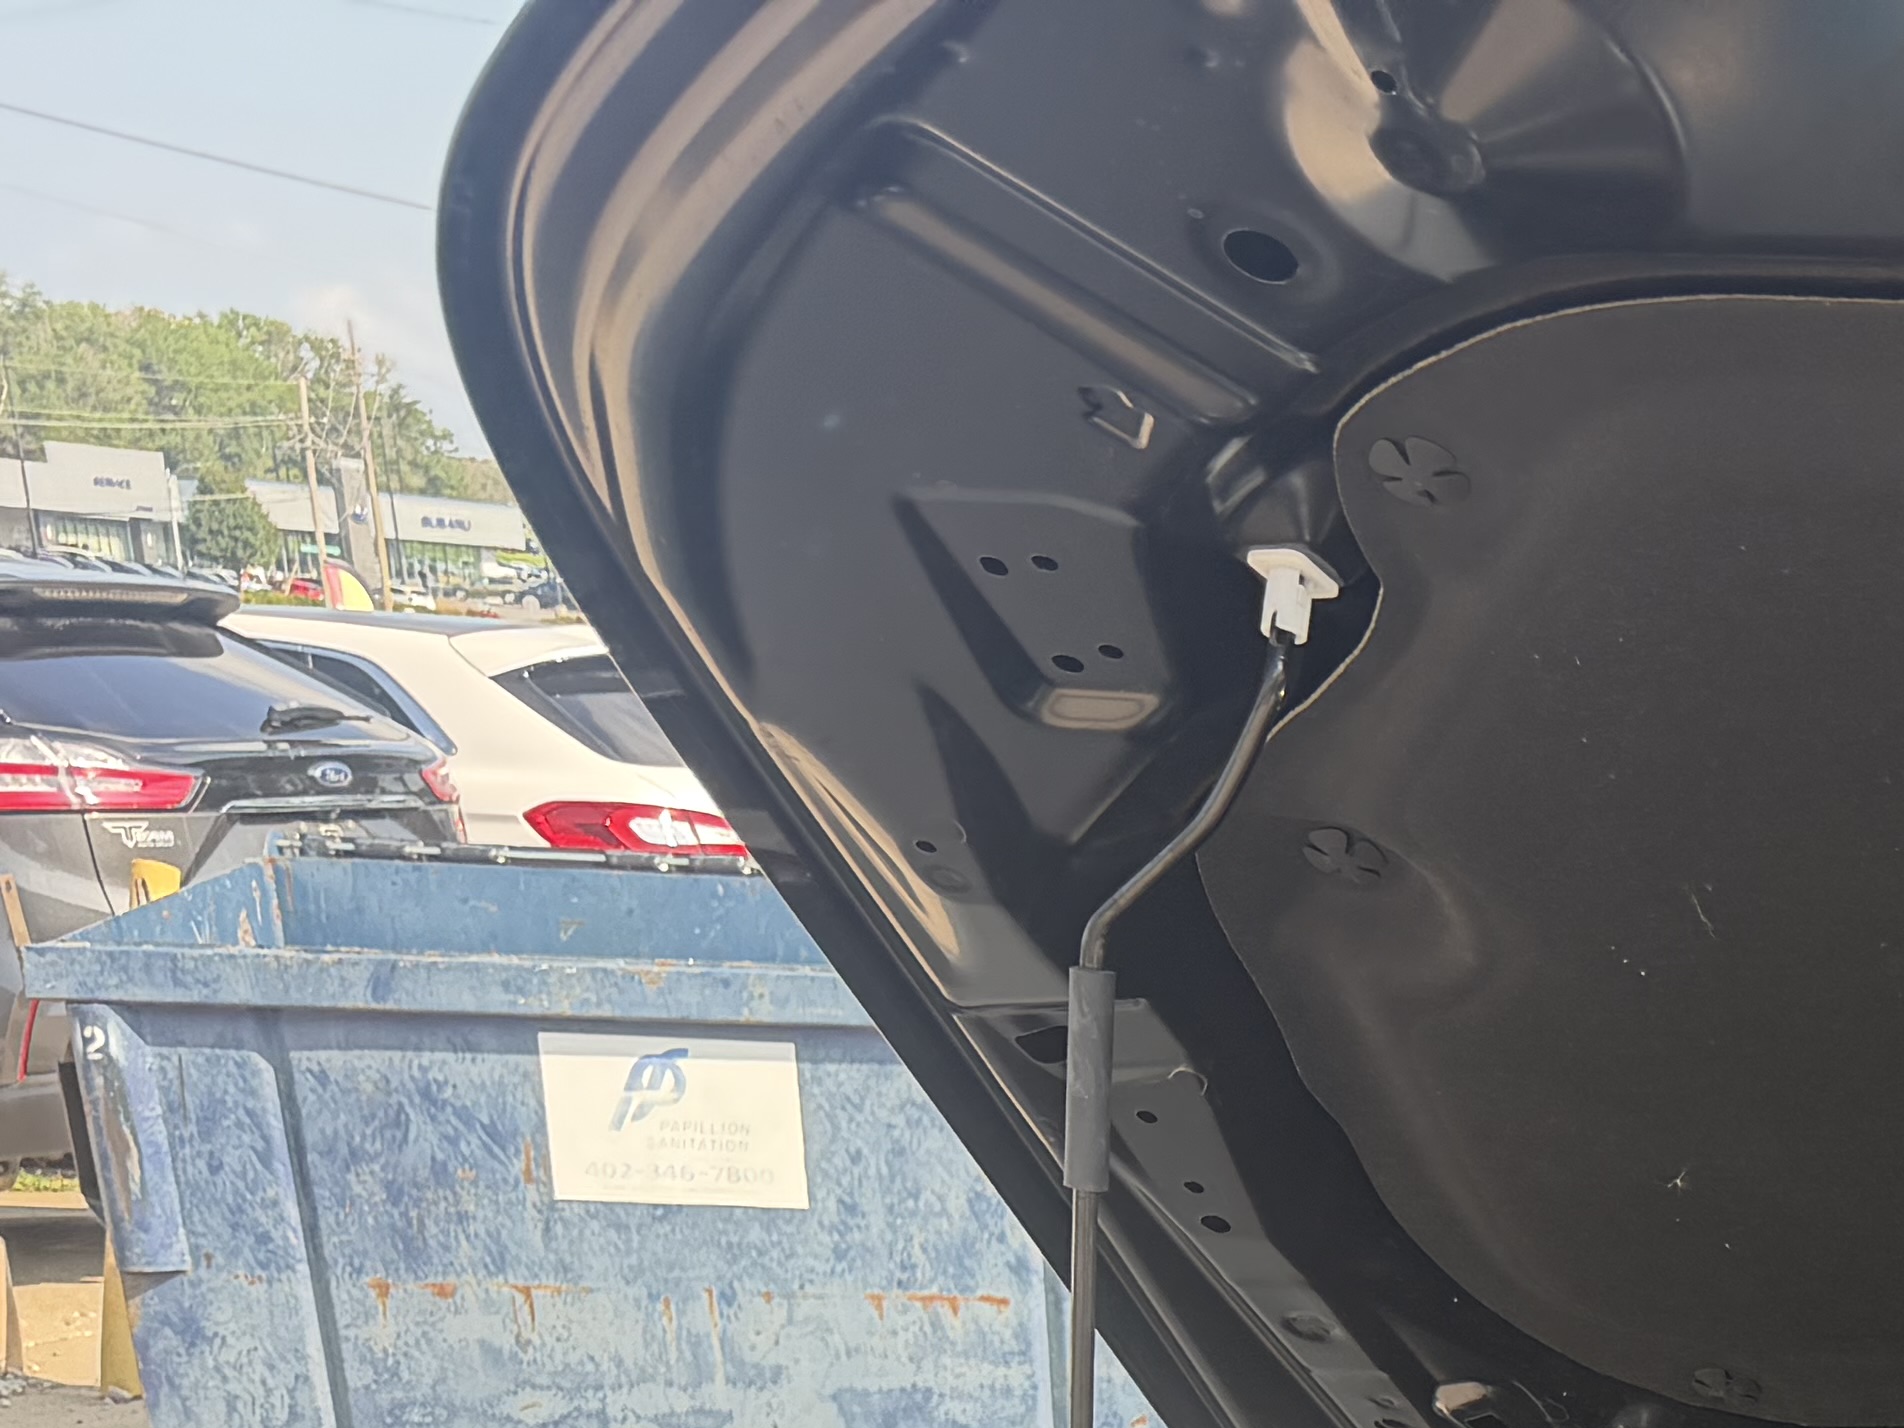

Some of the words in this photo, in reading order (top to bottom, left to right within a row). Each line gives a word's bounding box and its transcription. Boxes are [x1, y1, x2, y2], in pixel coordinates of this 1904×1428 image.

[83, 1025, 105, 1060] 2
[660, 1120, 751, 1136] PAPILLION
[648, 1136, 750, 1153] SANITATION
